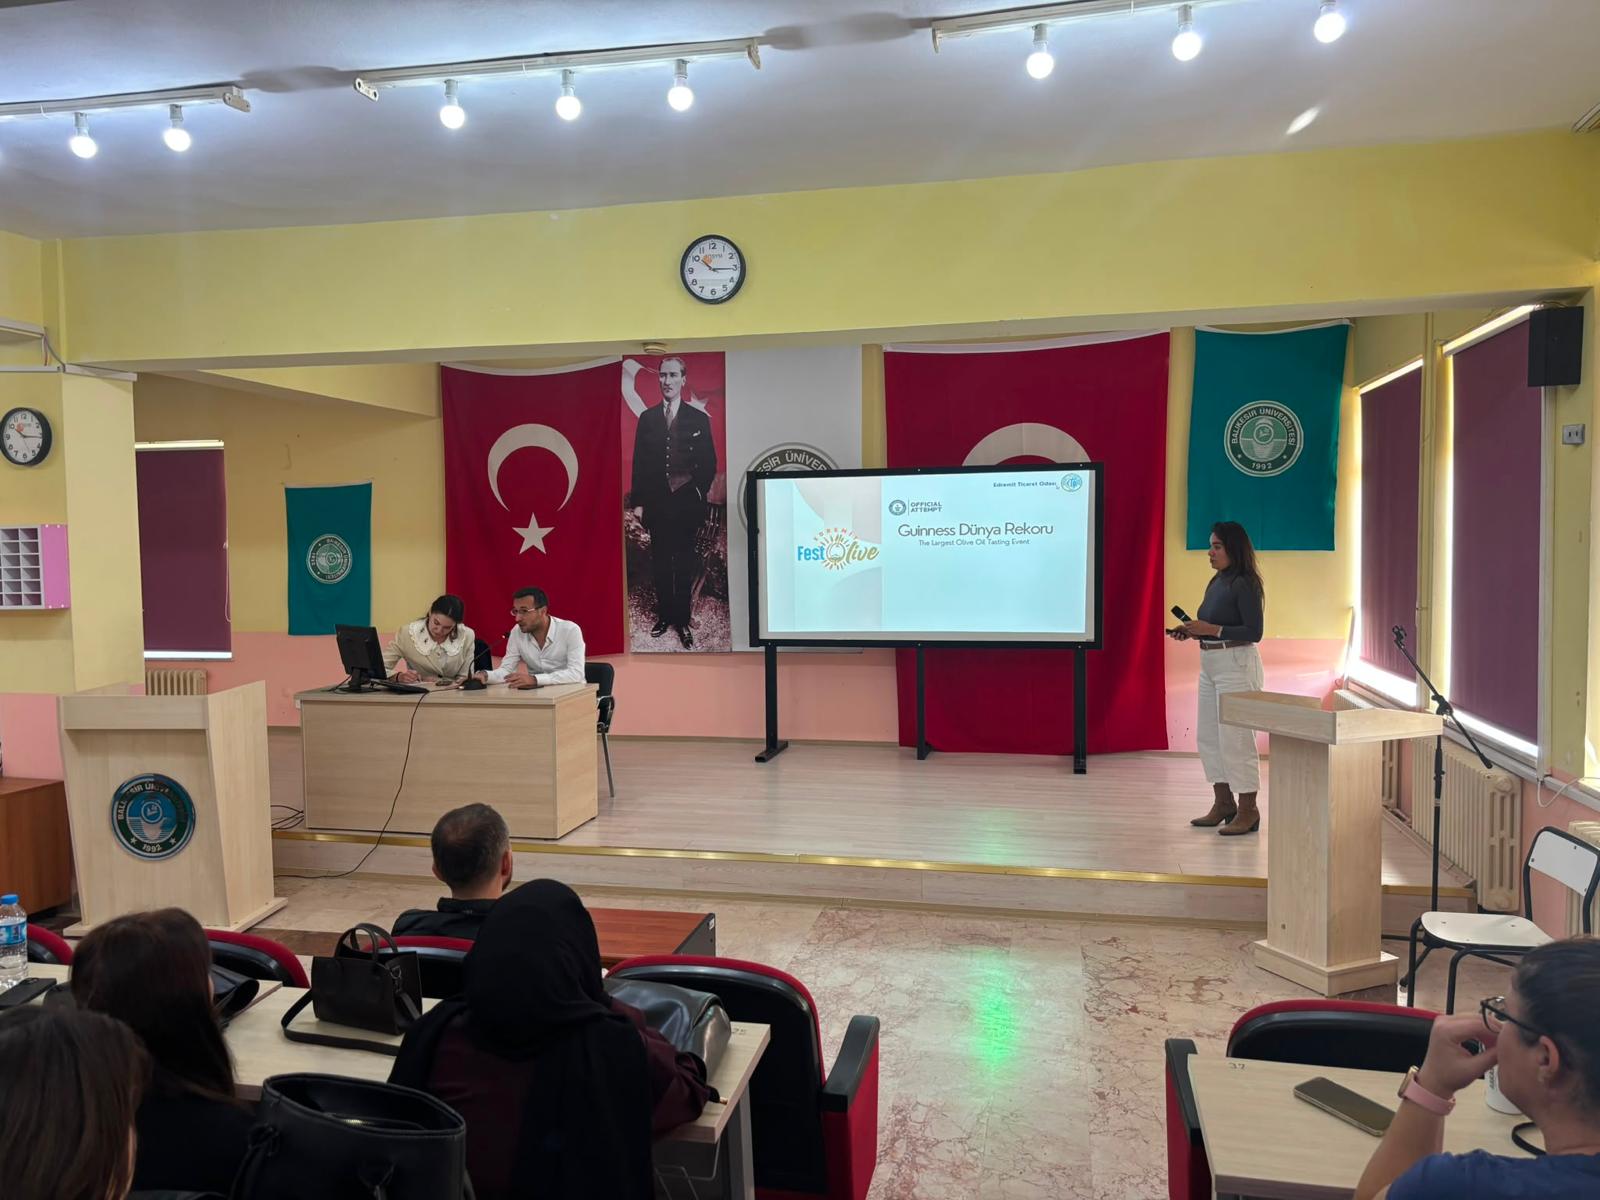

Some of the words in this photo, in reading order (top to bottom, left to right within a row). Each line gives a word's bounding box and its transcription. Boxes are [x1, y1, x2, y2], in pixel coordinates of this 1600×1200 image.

[1251, 462, 1273, 470] 1992
[898, 523, 956, 537] Guinness
[959, 522, 1001, 539] Dünya
[1004, 522, 1054, 535] Rekoru
[931, 539, 955, 548] Largest
[987, 538, 1010, 547] Tasting
[142, 843, 162, 853] 1992
